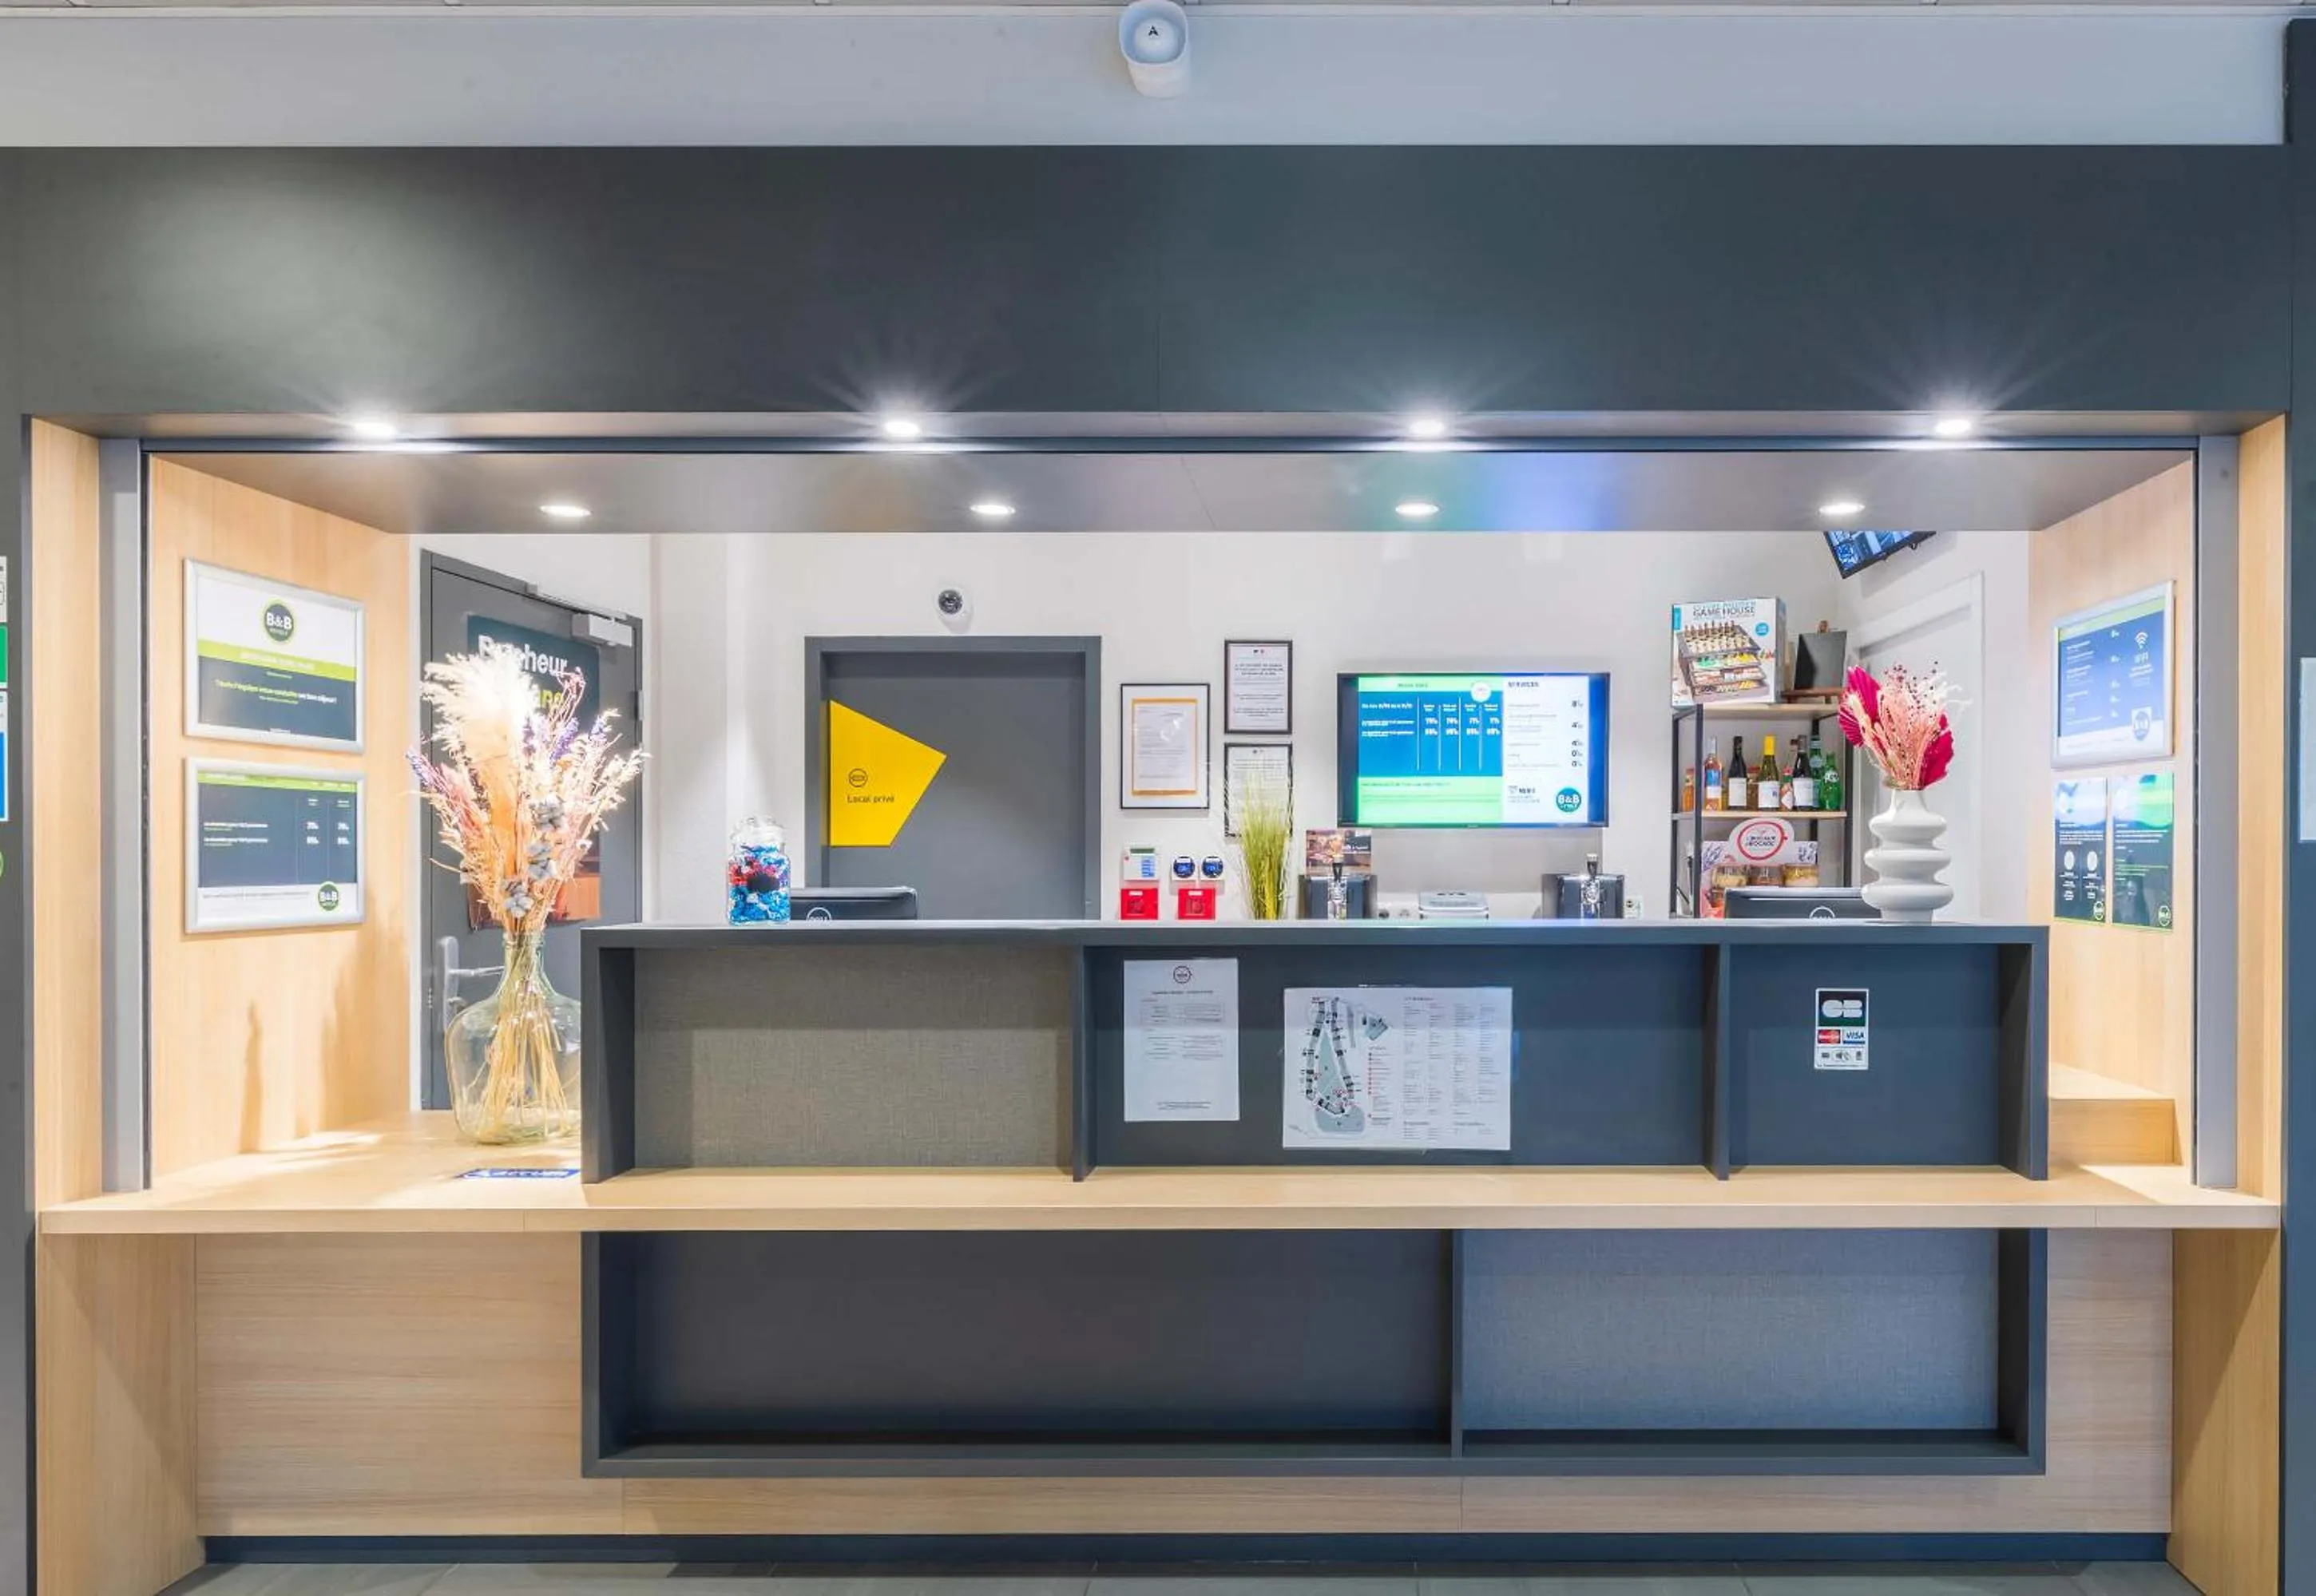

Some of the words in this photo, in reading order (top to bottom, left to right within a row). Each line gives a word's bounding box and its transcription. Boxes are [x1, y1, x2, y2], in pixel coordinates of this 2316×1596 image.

[266, 612, 293, 630] B&B
[478, 635, 569, 677] Bheur
[1558, 794, 1580, 805] B&B
